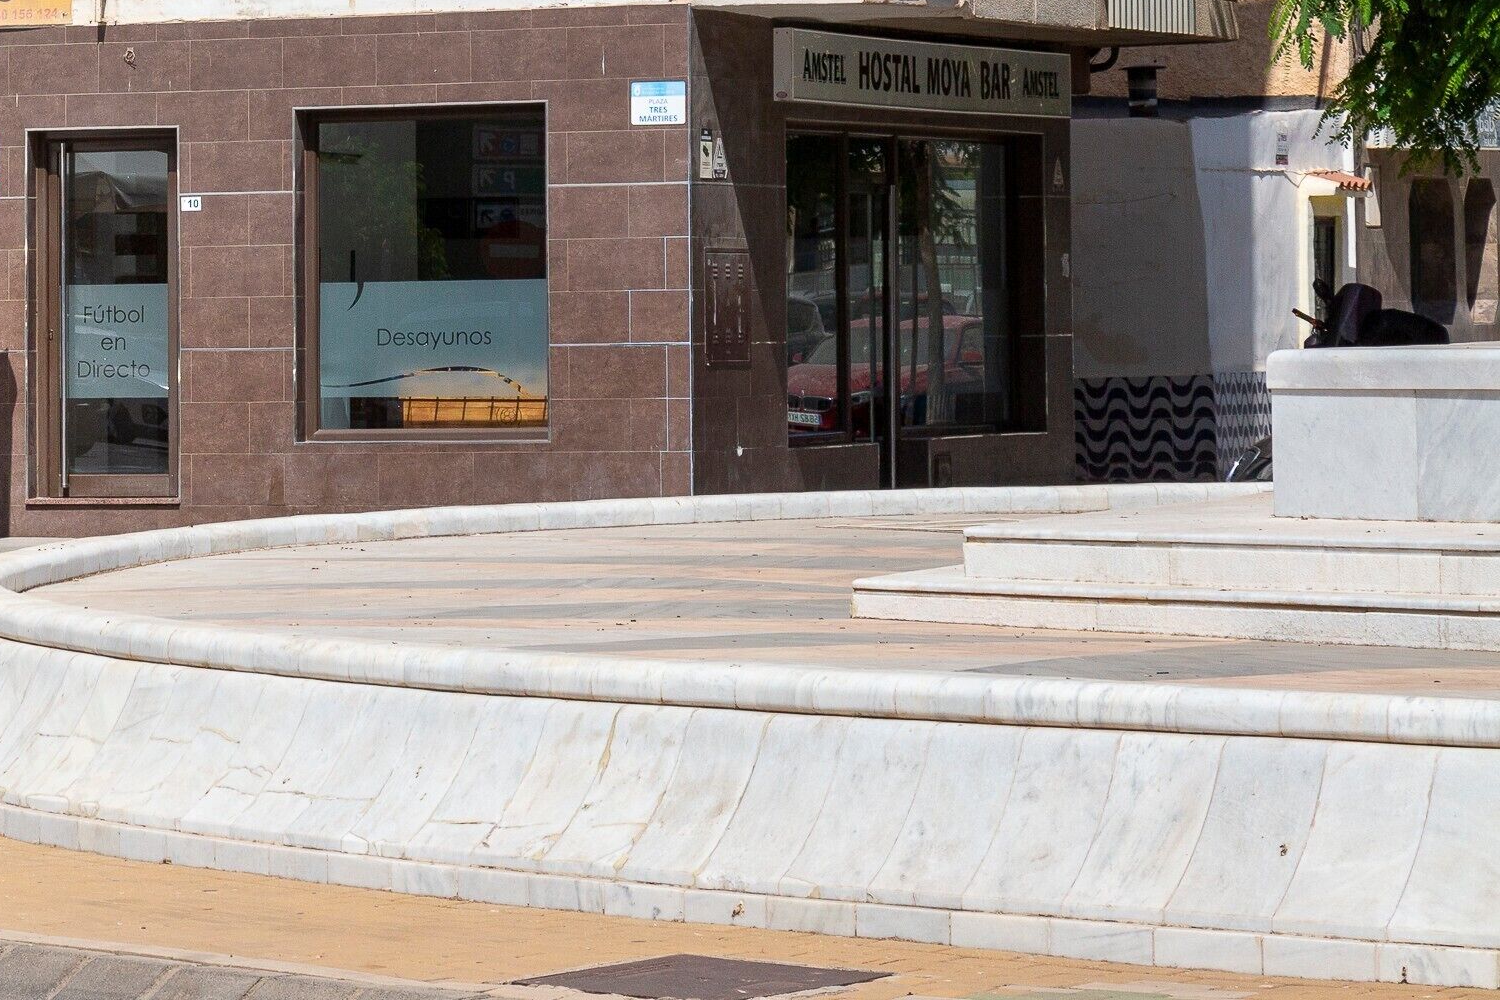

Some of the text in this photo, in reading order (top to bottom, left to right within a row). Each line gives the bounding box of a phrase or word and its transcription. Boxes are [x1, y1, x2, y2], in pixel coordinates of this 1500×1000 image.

[803, 48, 1060, 100] AMSTEL HOSTAL MOYA BAR AMSTEL
[187, 198, 199, 209] 10
[83, 304, 145, 323] Fútbol
[100, 336, 126, 350] en
[377, 328, 492, 349] Desayunos
[77, 359, 150, 378] Directo
